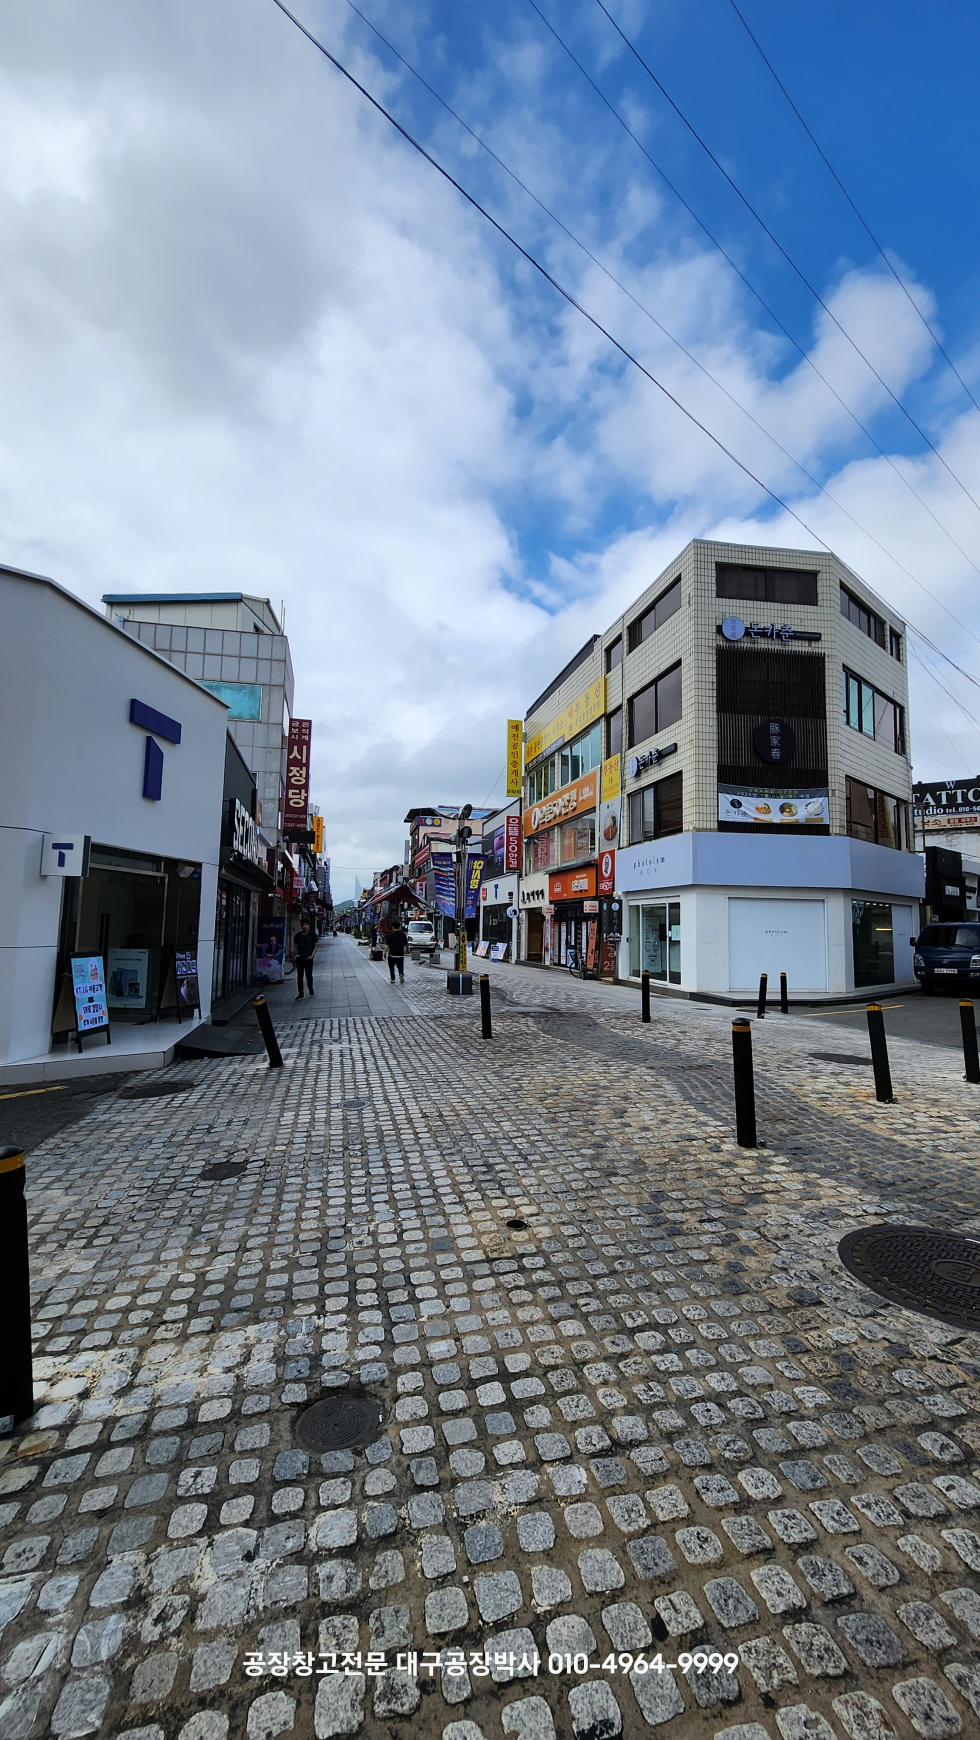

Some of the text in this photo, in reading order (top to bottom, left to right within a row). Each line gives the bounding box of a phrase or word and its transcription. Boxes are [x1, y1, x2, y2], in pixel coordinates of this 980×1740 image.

[510, 724, 520, 787] 예전공인중개사
[769, 722, 782, 760] 豚家春
[287, 745, 307, 808] 시정당
[603, 757, 619, 777] 부동산
[508, 817, 520, 868] 으뜸50안경
[633, 856, 665, 870] photoism
[640, 868, 657, 876] BOX
